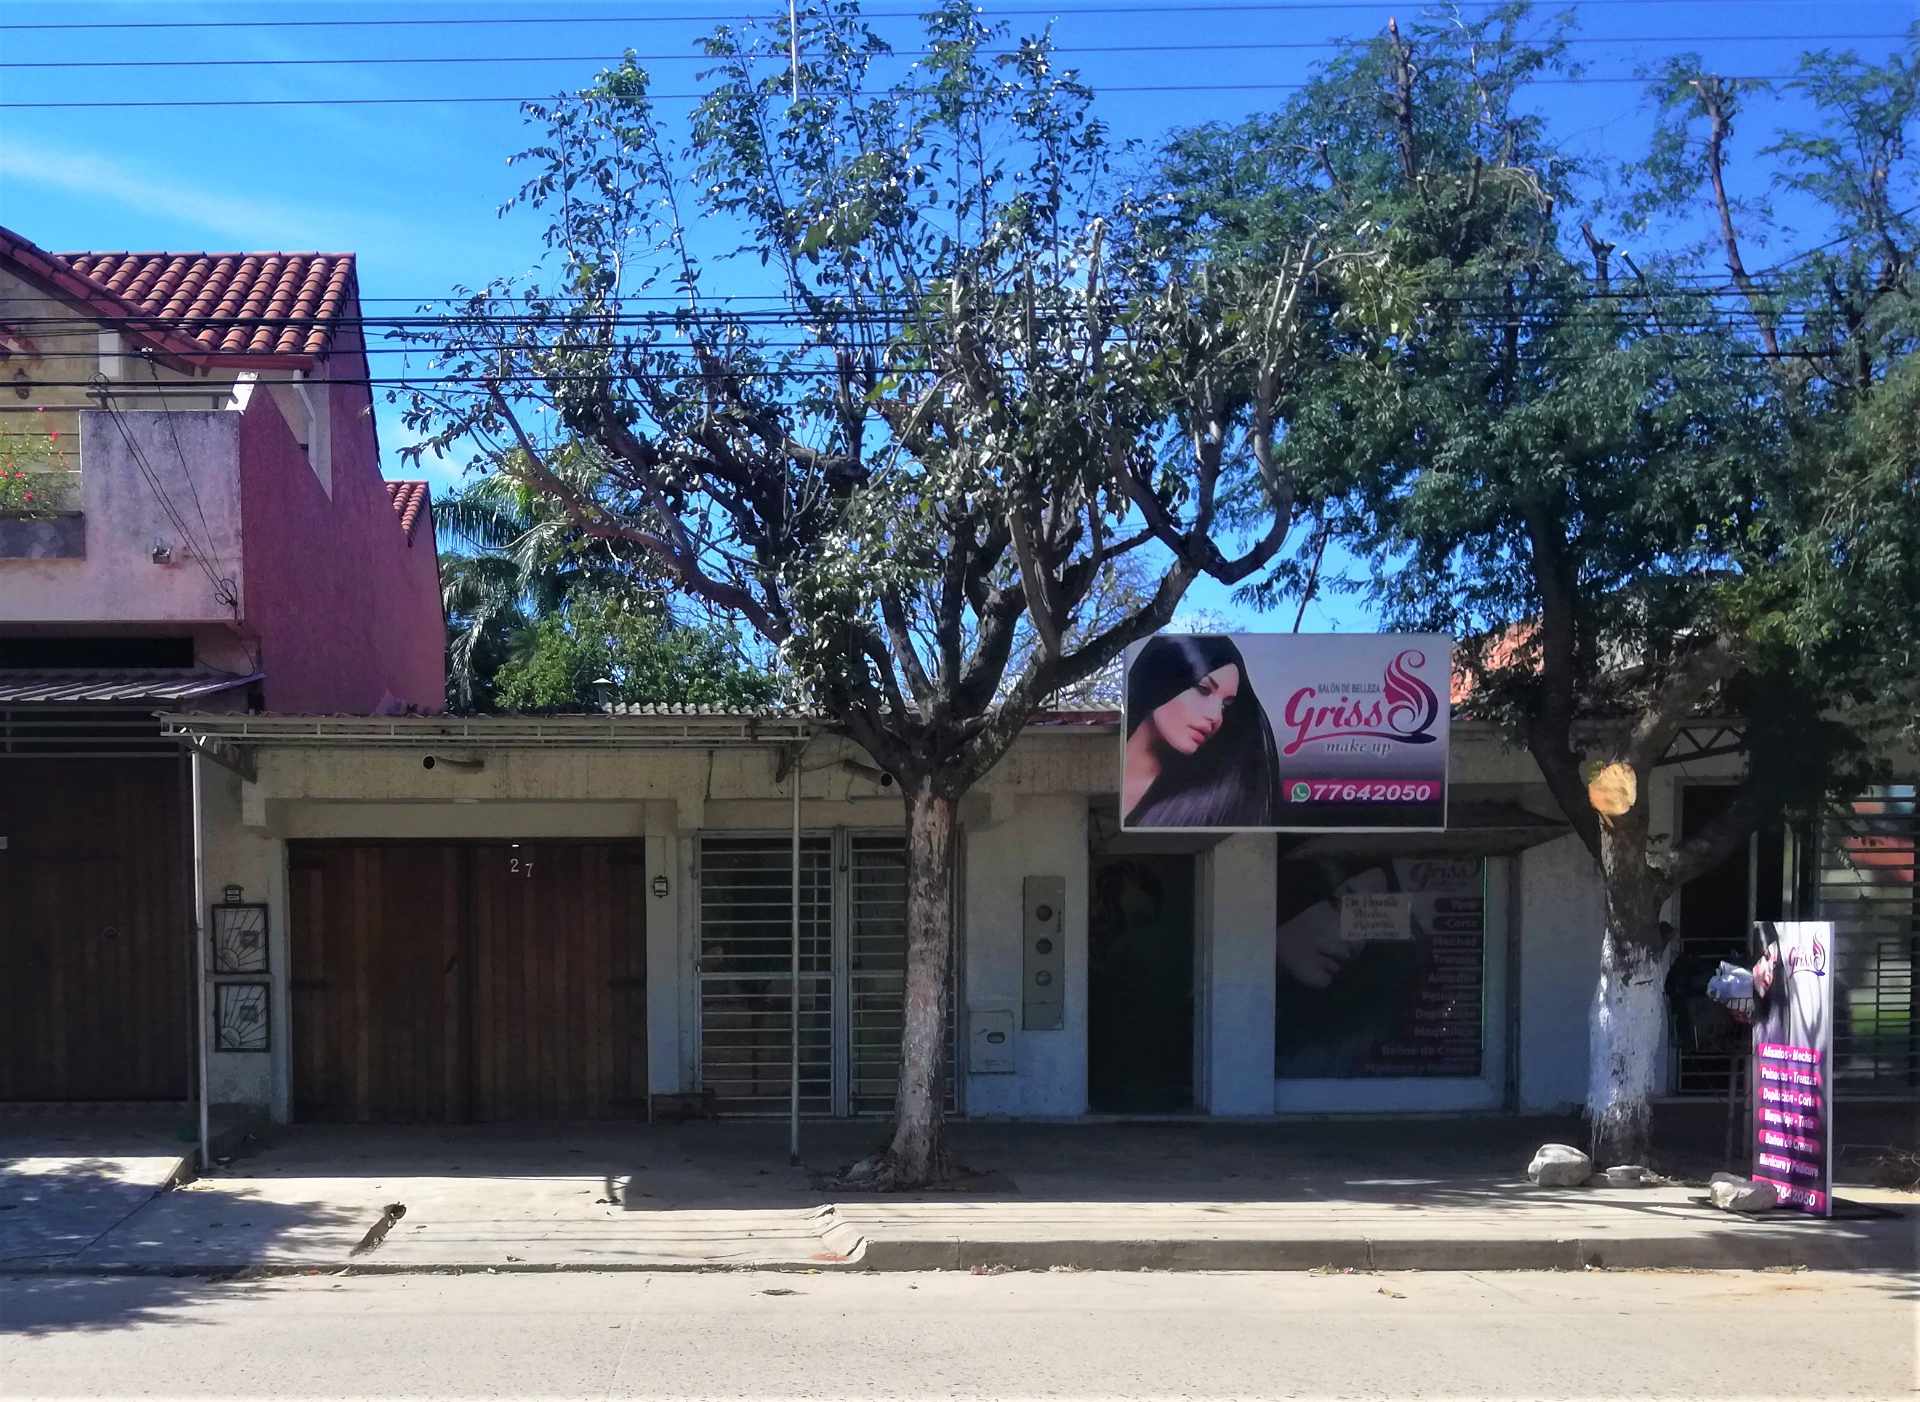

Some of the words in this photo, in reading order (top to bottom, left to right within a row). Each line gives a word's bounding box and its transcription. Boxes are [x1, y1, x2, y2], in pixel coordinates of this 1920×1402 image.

[1351, 683, 1381, 693] BELLEZA
[1283, 687, 1383, 755] Griss
[1326, 739, 1365, 752] make
[1372, 743, 1391, 756] up
[1313, 785, 1431, 801] 77642050
